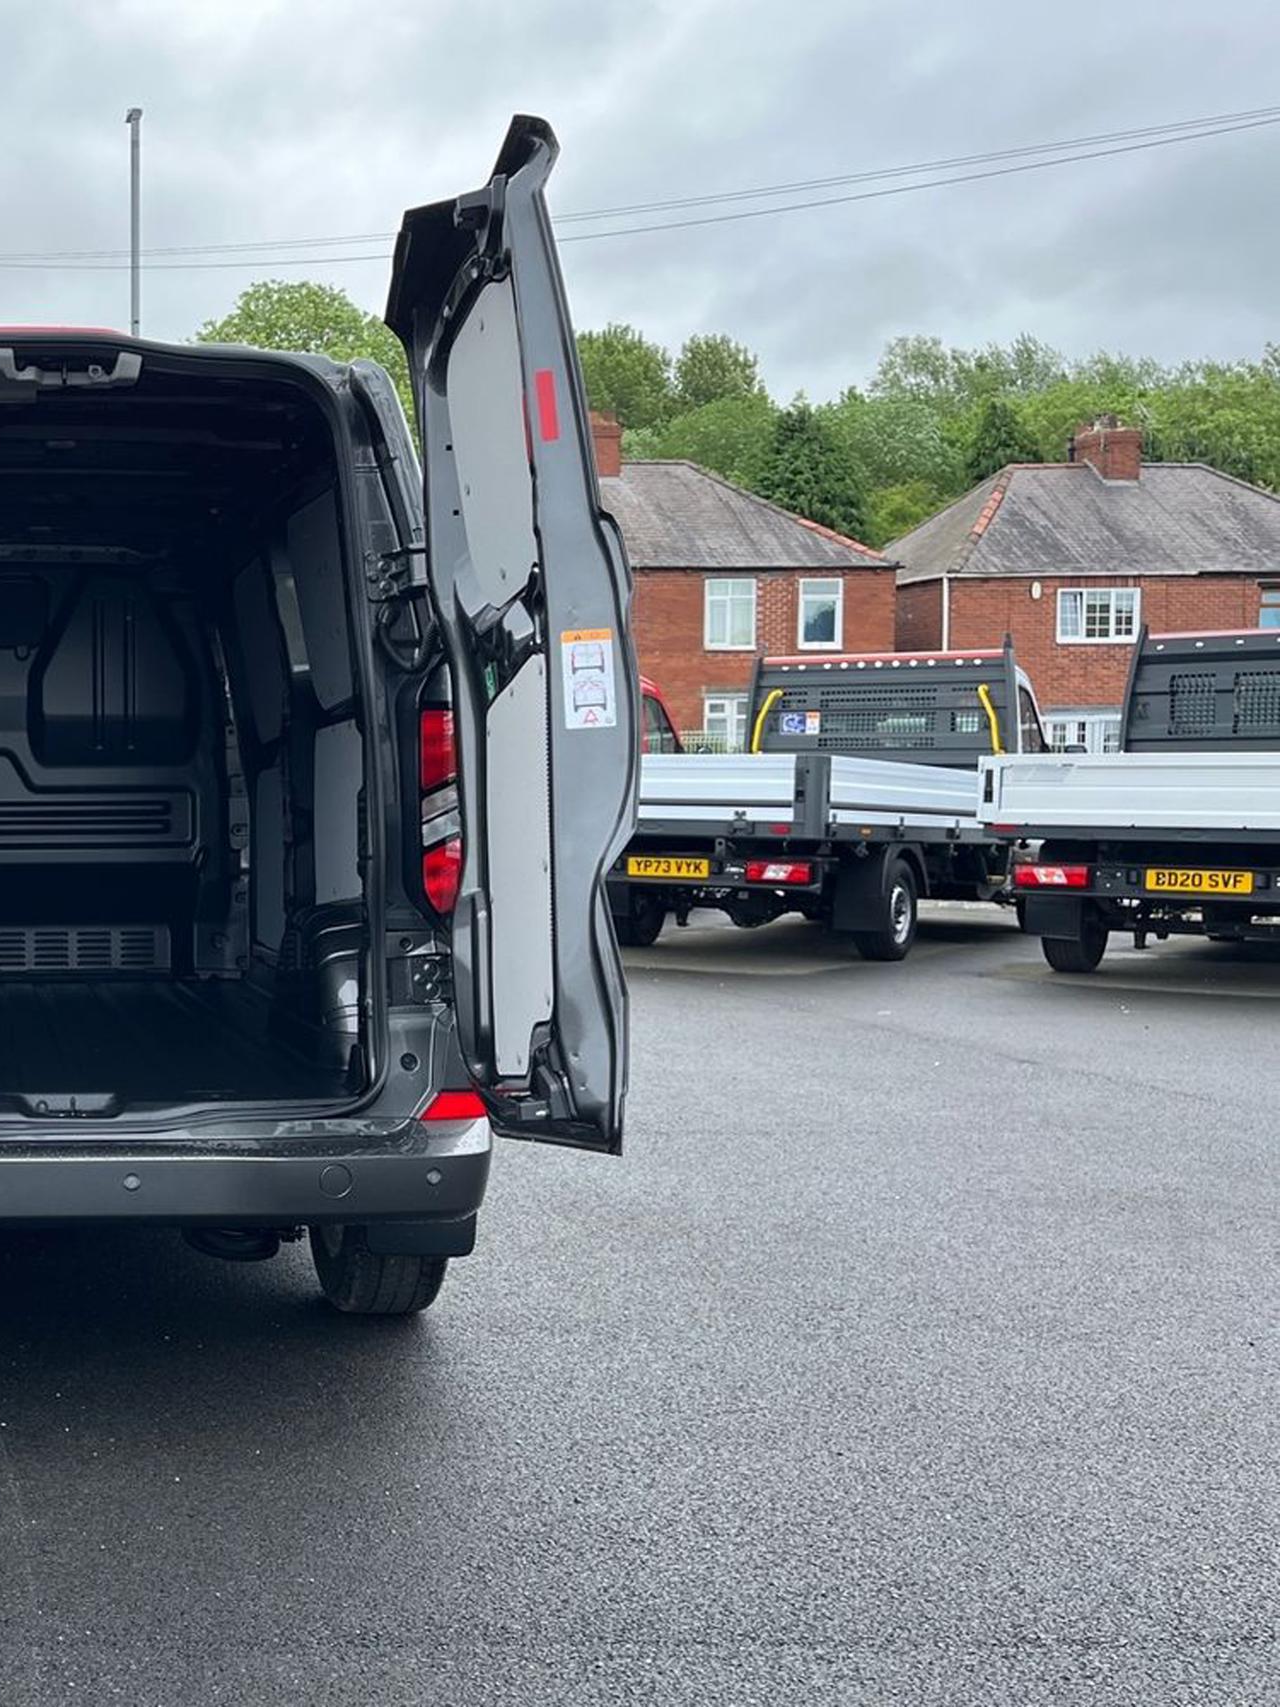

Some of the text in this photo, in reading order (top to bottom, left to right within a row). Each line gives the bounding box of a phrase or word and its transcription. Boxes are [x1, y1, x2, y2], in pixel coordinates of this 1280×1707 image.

[635, 859, 703, 874] YP73 VYK
[1154, 871, 1245, 889] BD20 SVF
